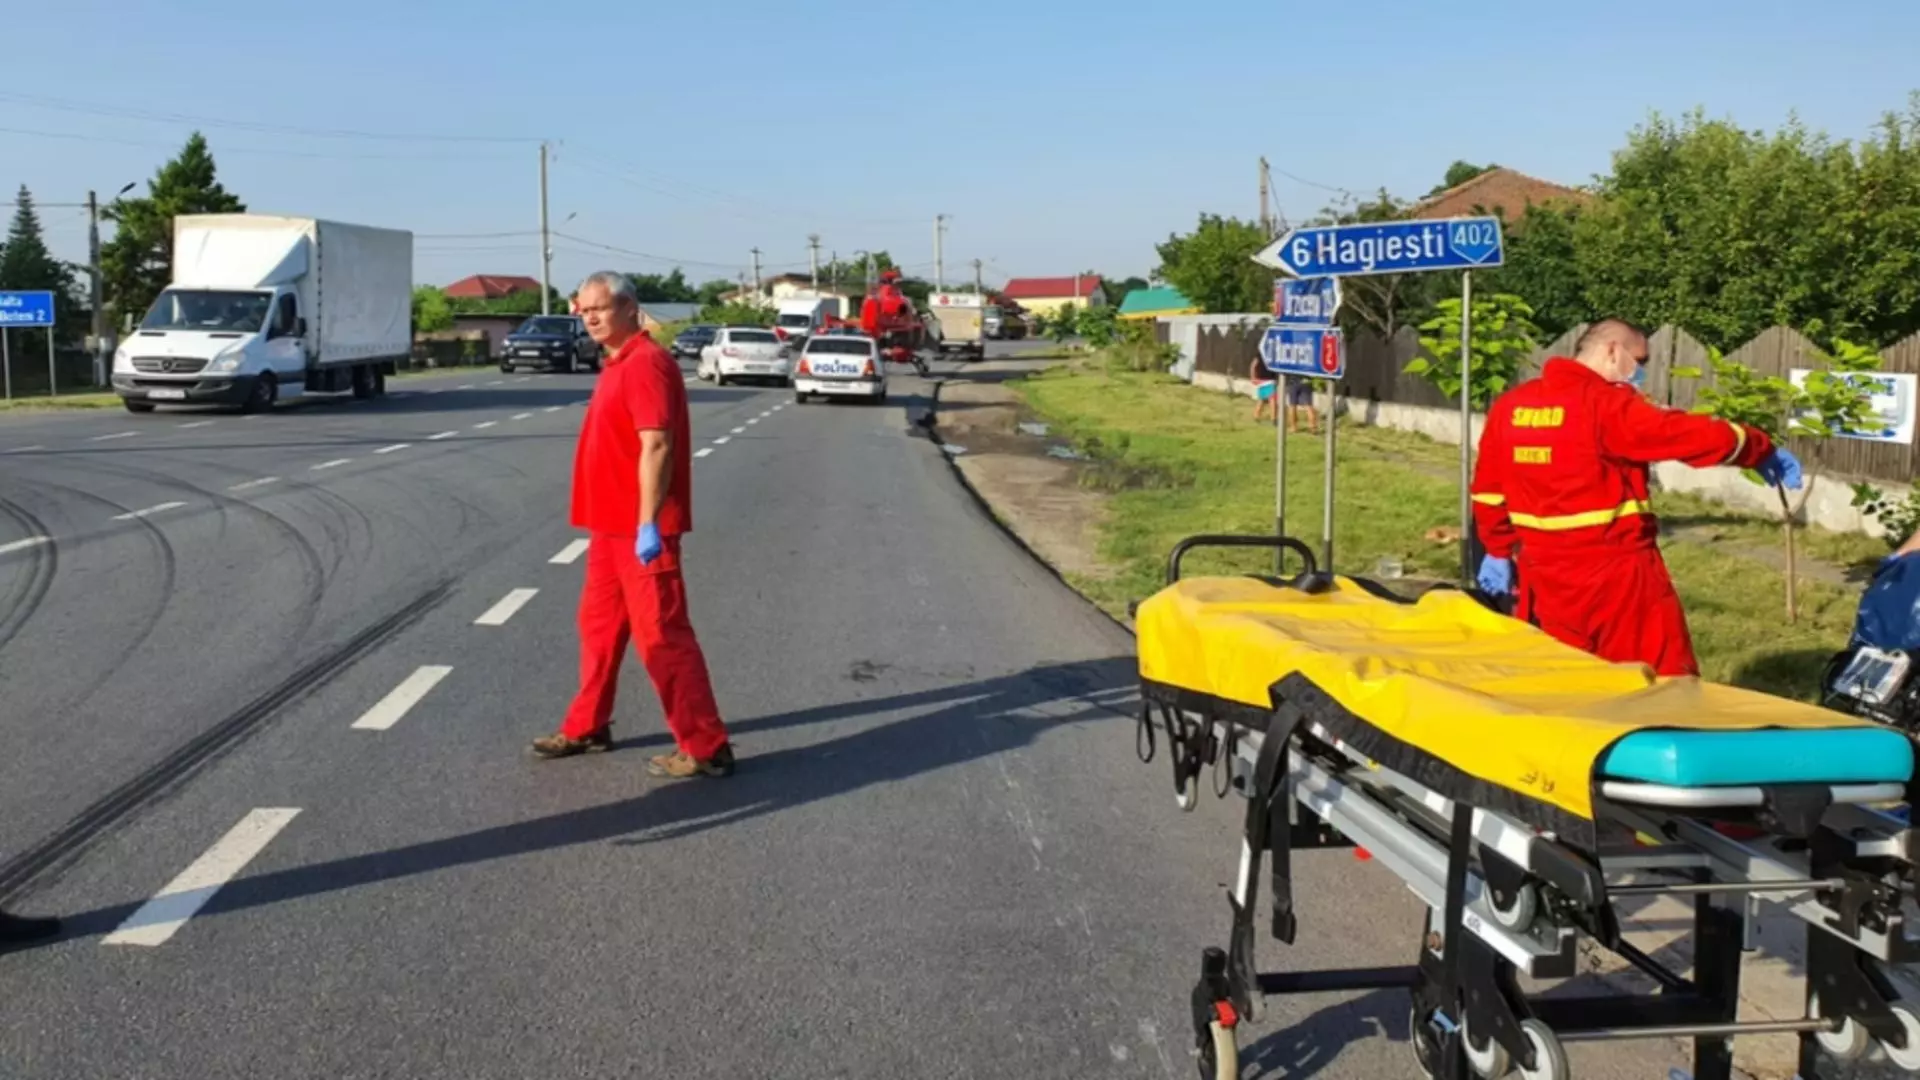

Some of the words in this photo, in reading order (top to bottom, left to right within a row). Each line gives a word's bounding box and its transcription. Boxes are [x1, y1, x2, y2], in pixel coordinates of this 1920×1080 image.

[1292, 236, 1311, 267] 6
[1316, 225, 1445, 272] Hagiești
[1454, 223, 1495, 247] 402
